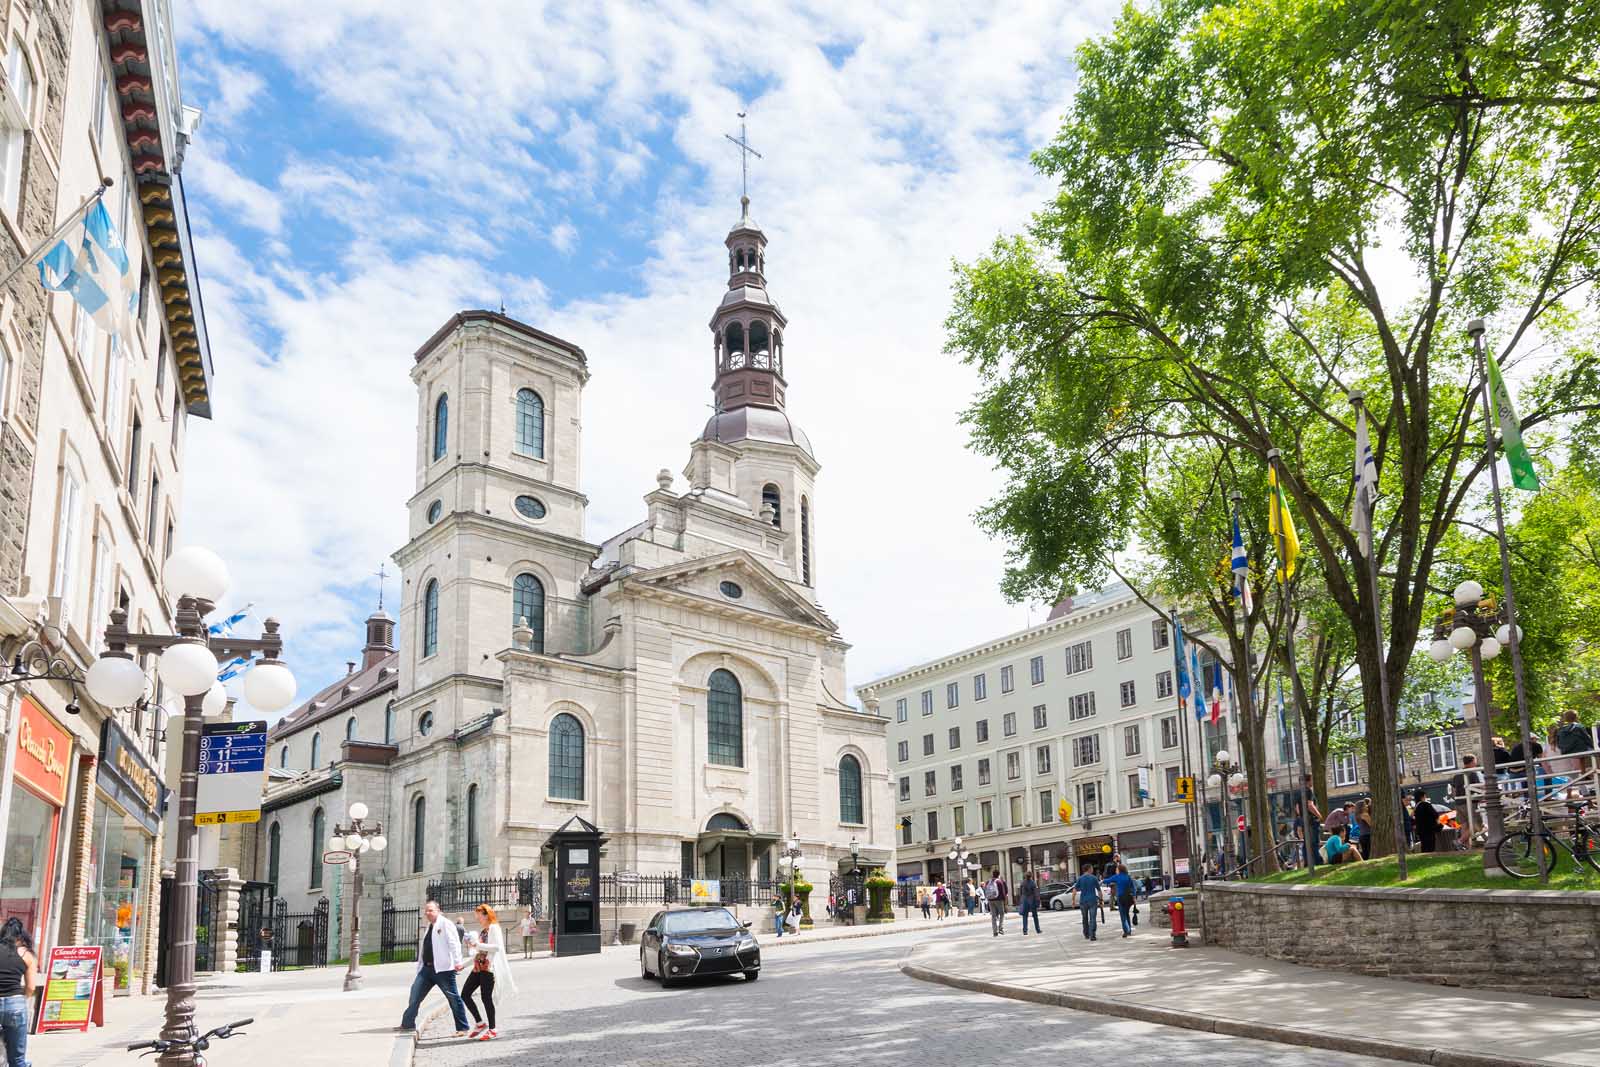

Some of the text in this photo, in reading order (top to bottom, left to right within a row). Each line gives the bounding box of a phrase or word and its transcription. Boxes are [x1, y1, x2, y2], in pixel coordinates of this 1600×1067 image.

[225, 737, 232, 748] 3
[20, 717, 64, 790] Claude Berry
[218, 750, 230, 760] 11
[216, 763, 229, 773] 21
